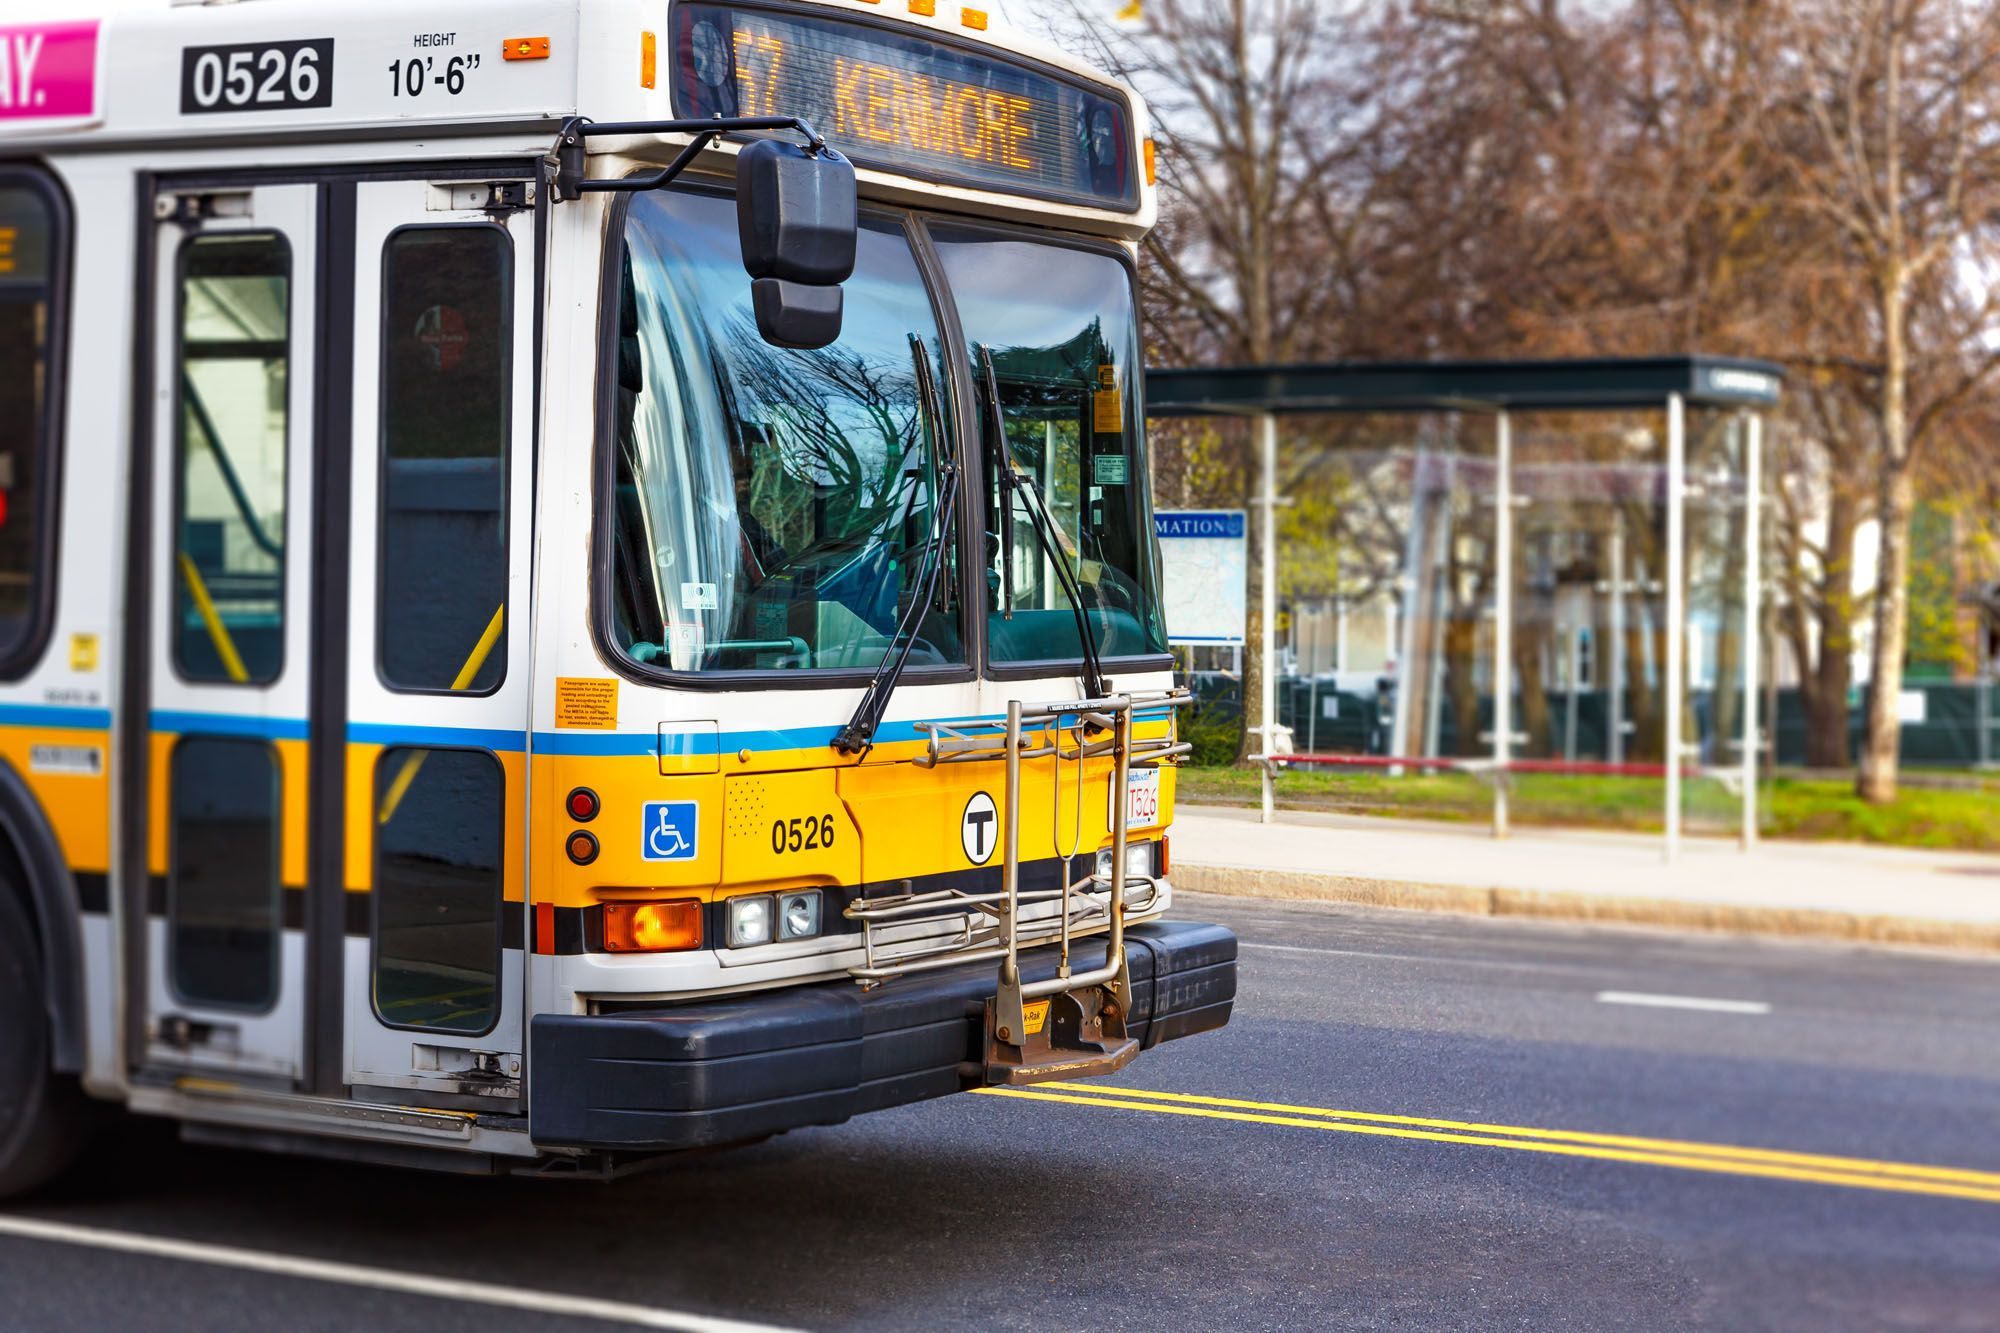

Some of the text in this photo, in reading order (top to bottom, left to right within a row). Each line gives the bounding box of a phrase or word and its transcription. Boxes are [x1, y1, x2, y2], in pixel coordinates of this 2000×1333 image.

[414, 33, 456, 47] HEIGHT
[193, 47, 319, 106] 0526
[835, 58, 1031, 169] KENMORE
[1130, 788, 1156, 817] T526
[772, 814, 834, 854] 0526
[967, 810, 993, 855] T
